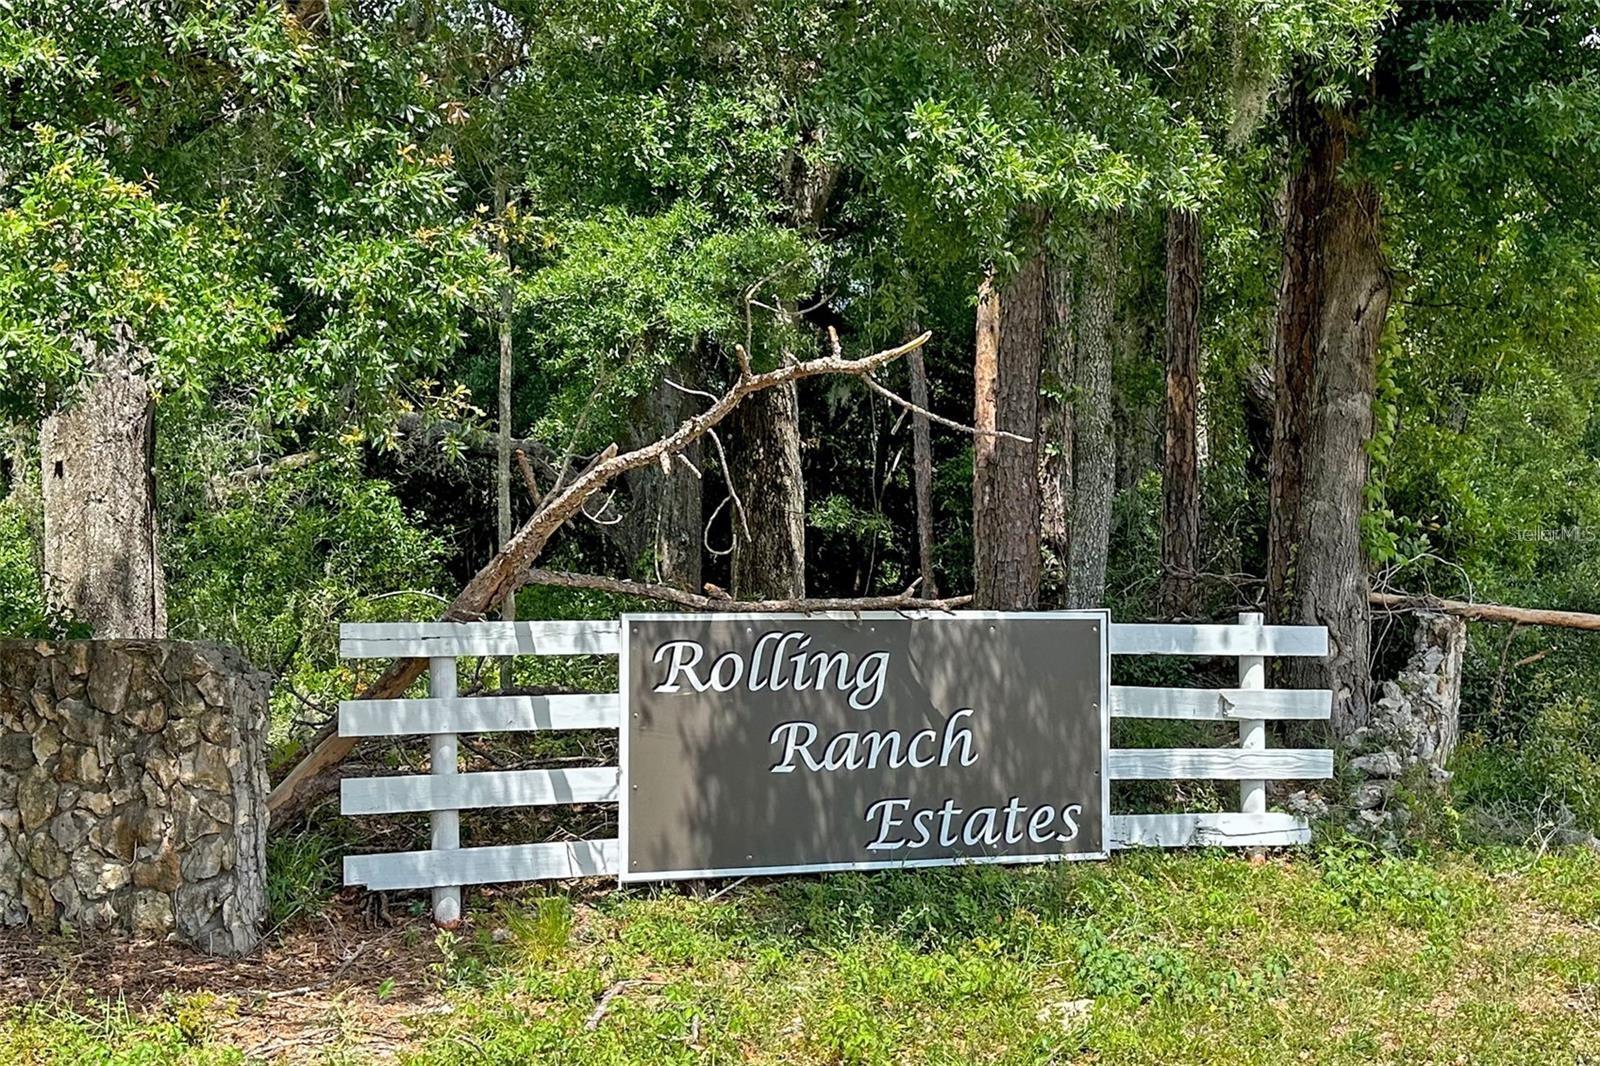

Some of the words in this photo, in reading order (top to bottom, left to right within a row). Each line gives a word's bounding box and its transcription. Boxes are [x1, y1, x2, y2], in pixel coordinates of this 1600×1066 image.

[653, 631, 891, 709] Rolling
[769, 708, 978, 773] Ranch
[865, 797, 1082, 850] Estates
